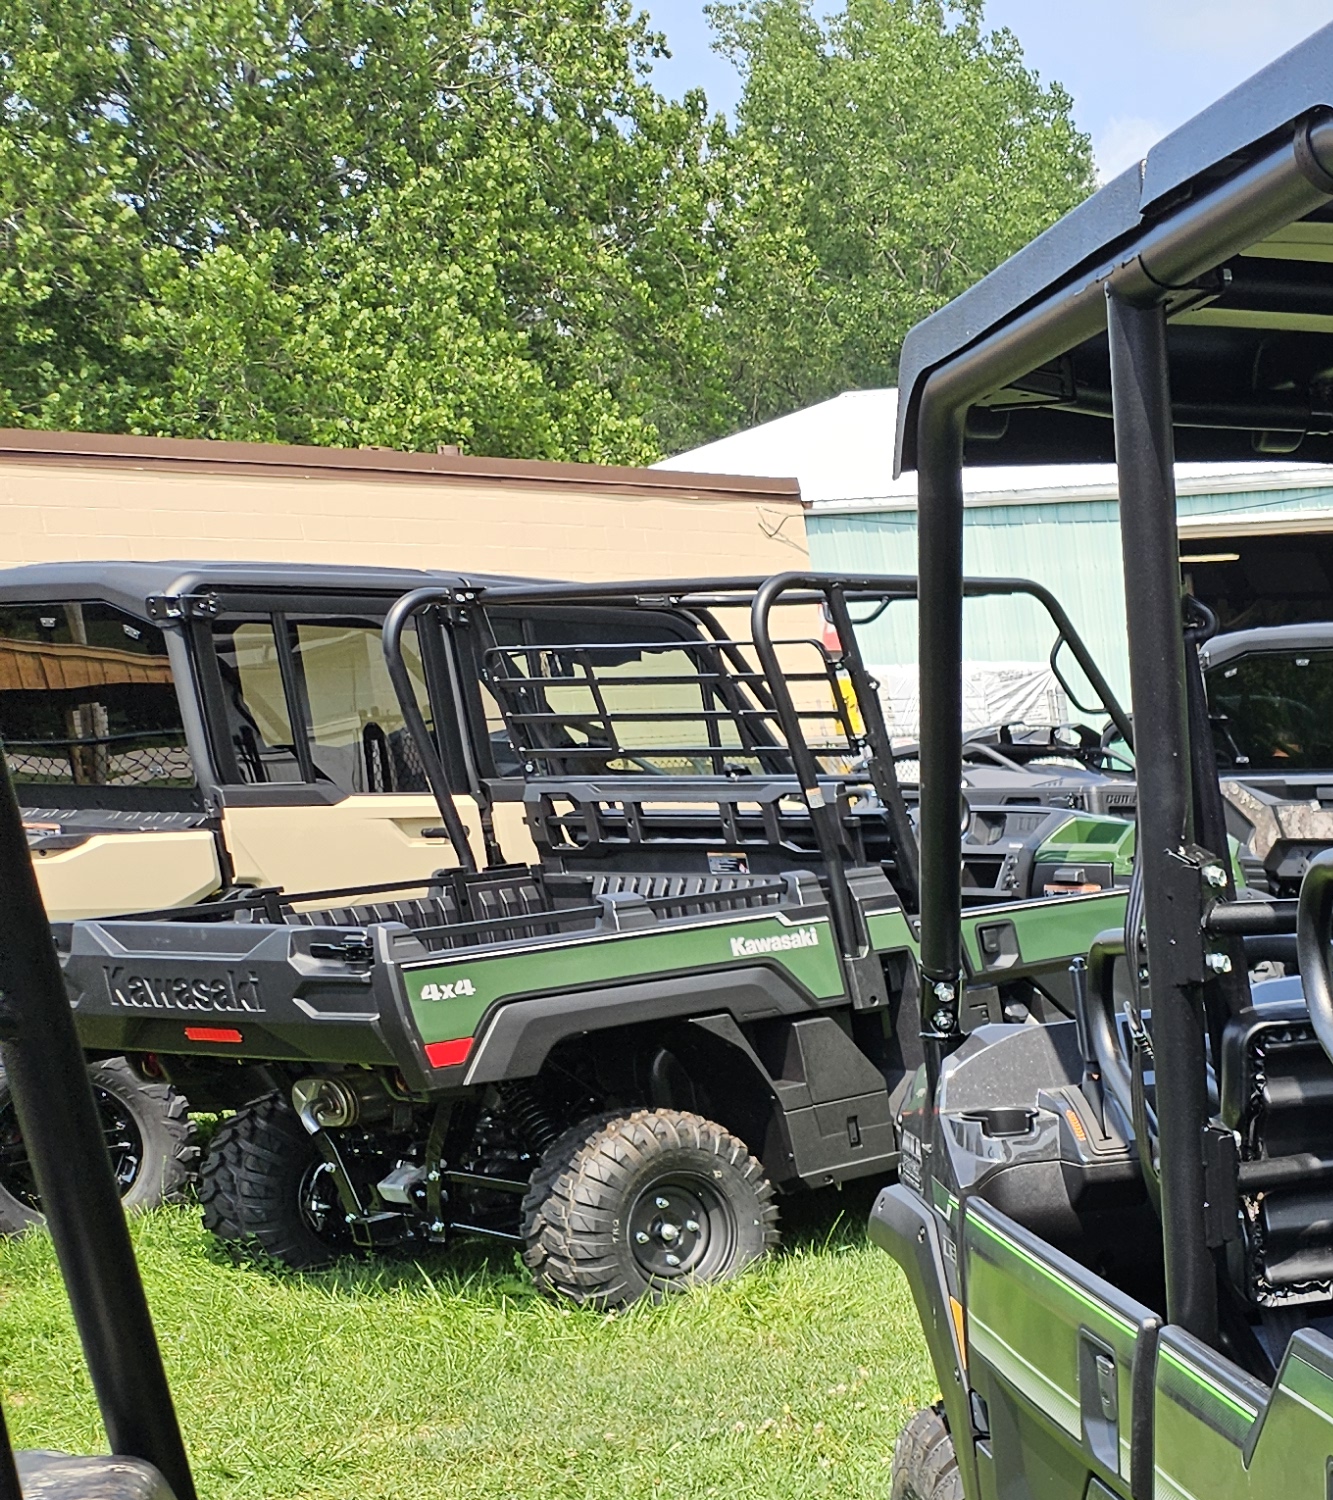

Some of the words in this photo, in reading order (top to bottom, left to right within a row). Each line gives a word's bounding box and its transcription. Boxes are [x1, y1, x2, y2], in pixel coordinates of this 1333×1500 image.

[730, 926, 819, 957] Kawasaki
[103, 965, 266, 1012] Kawasaki
[421, 979, 476, 1001] 4x4
